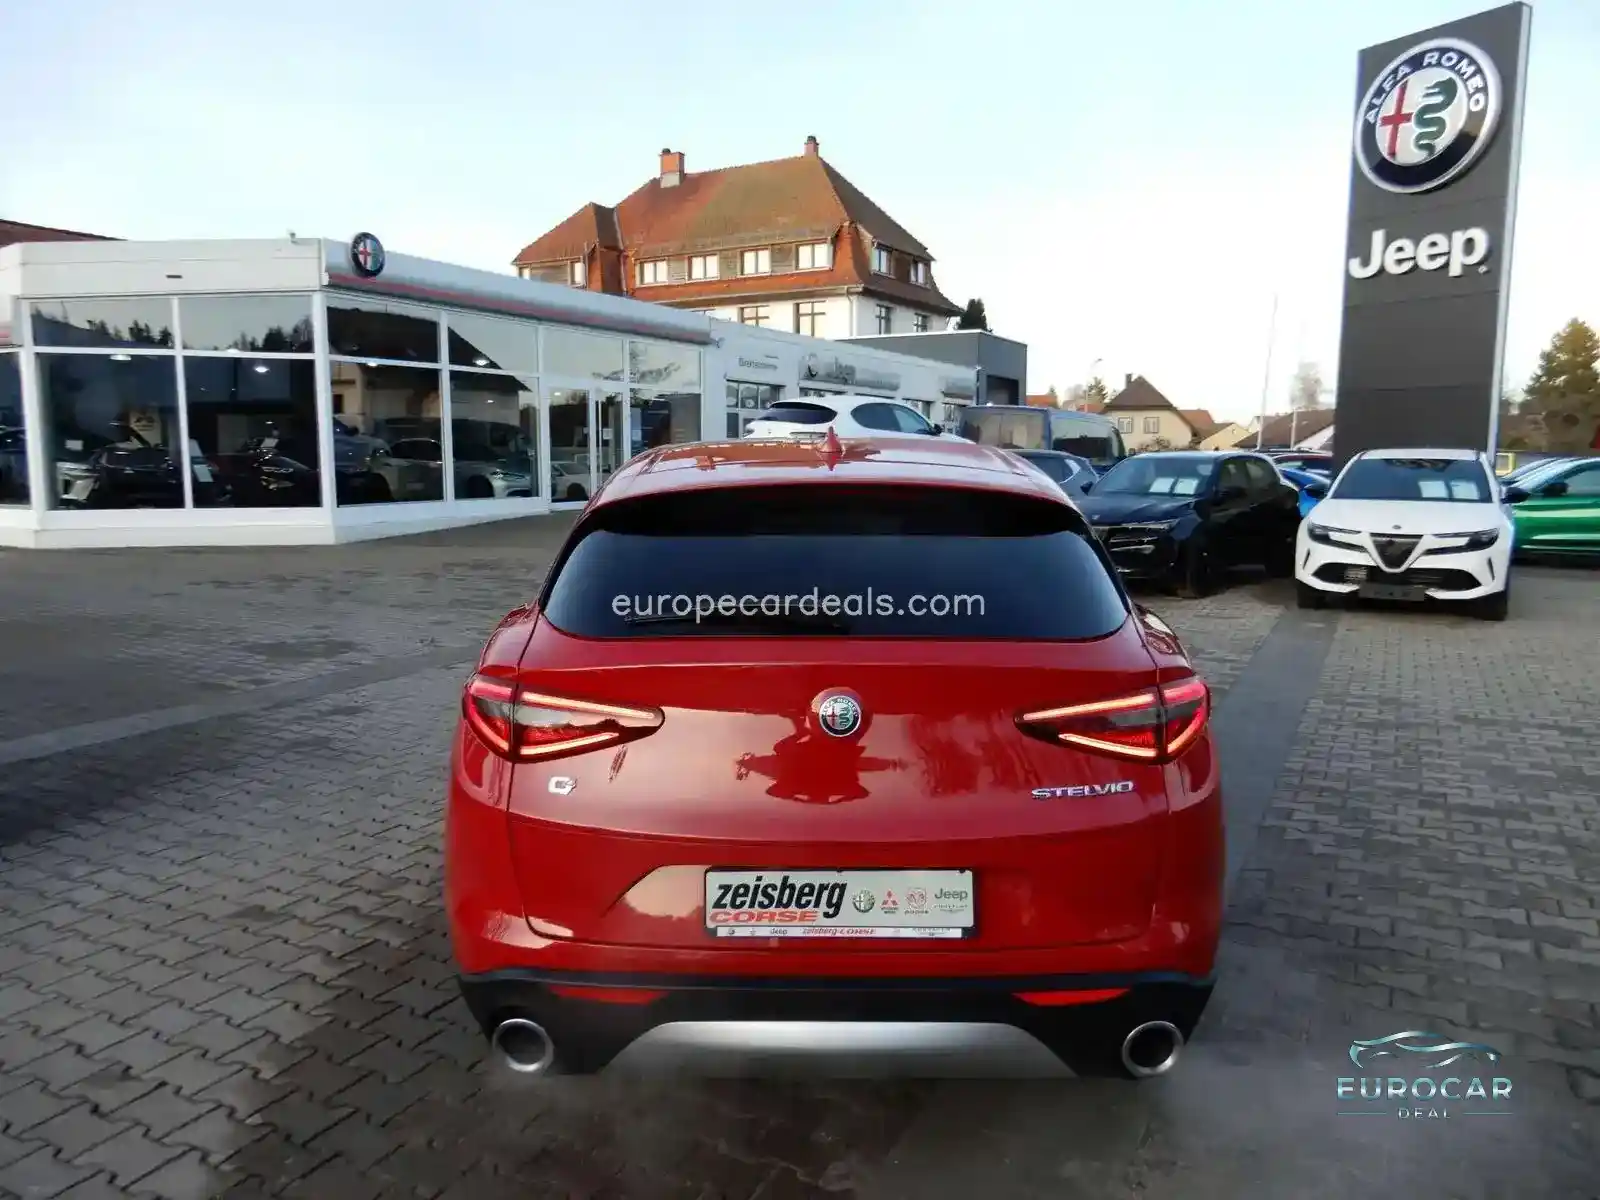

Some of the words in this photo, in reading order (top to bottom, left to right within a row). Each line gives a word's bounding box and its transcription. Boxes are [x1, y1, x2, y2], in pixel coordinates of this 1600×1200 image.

[1364, 64, 1413, 125] ALFA
[1423, 50, 1487, 113] ROMEO
[1348, 226, 1489, 279] Jeep
[1031, 781, 1134, 799] STELVIO
[712, 875, 847, 919] zeisberg
[934, 888, 968, 902] Jeep
[709, 911, 819, 924] CORSE
